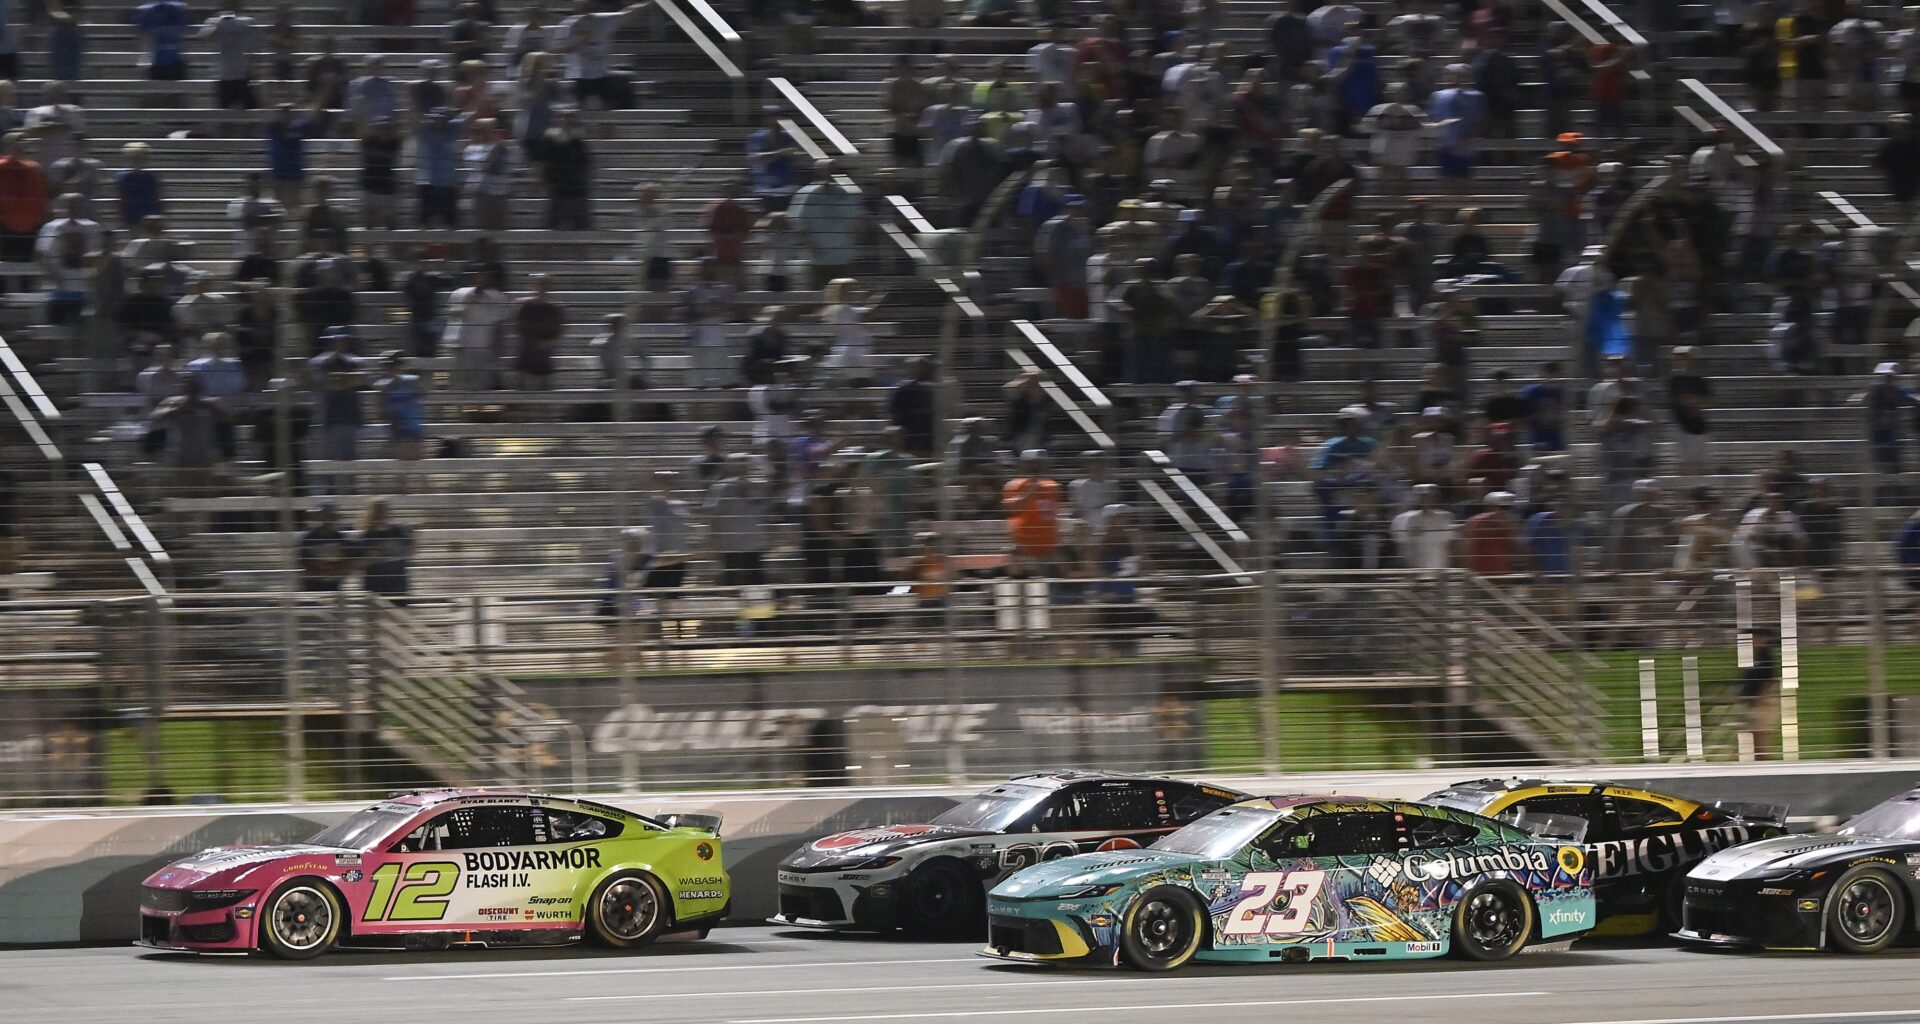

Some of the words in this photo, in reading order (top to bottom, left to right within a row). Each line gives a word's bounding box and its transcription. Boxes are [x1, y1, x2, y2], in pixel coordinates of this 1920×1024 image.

[463, 847, 602, 871] BODYARMOR
[1403, 845, 1549, 881] Columbia
[283, 862, 328, 873] GOODYEAR
[466, 874, 508, 889] FLASH
[512, 873, 531, 888] I.V.
[679, 877, 722, 885] WABASH
[361, 861, 461, 922] 12
[679, 891, 723, 899] MENARDS
[528, 896, 572, 905] Snap-on
[1222, 870, 1329, 935] 23
[478, 907, 519, 915] DISCOUNT
[1549, 909, 1586, 925] xfinity
[1407, 943, 1431, 951] Mobil
